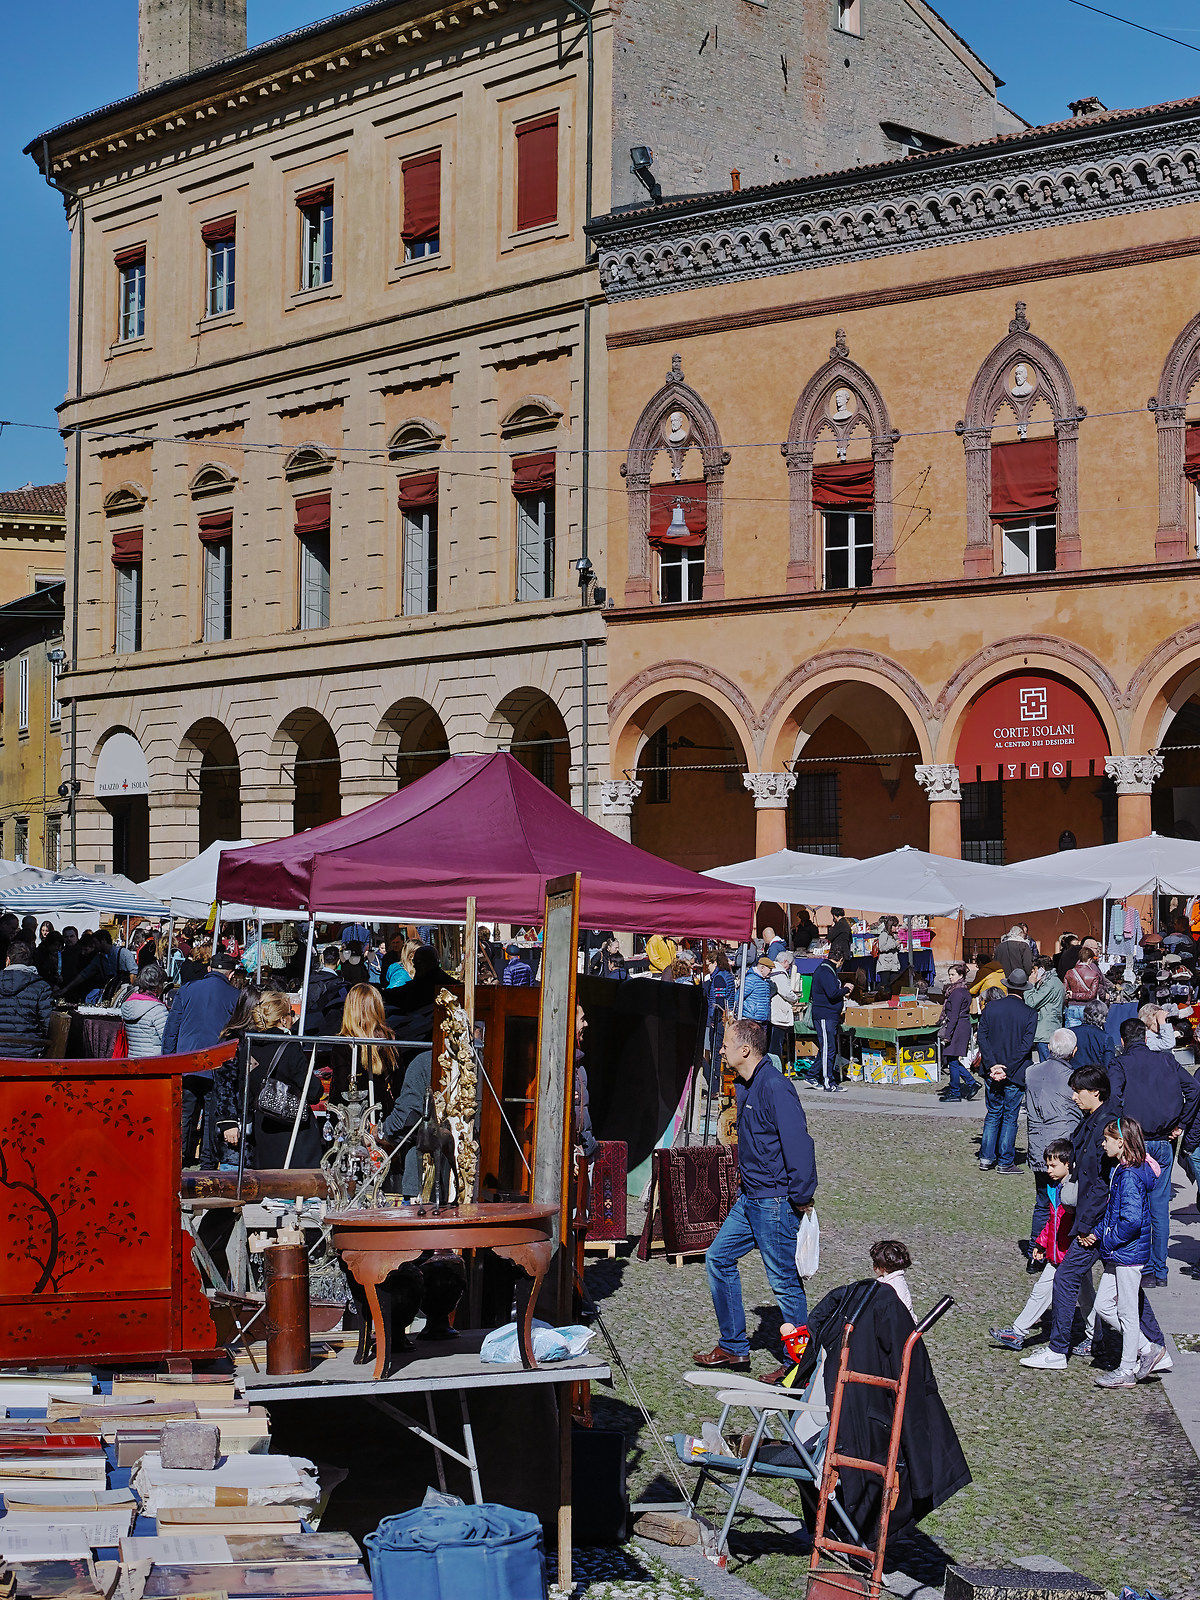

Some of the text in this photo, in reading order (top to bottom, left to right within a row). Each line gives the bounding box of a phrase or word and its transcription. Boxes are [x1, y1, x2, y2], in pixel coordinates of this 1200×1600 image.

[993, 724, 1075, 739] CORTE ISOLANI
[1004, 740, 1031, 748] CENTRO
[1045, 738, 1075, 746] DESIDERI
[131, 781, 149, 789] ISOLAN
